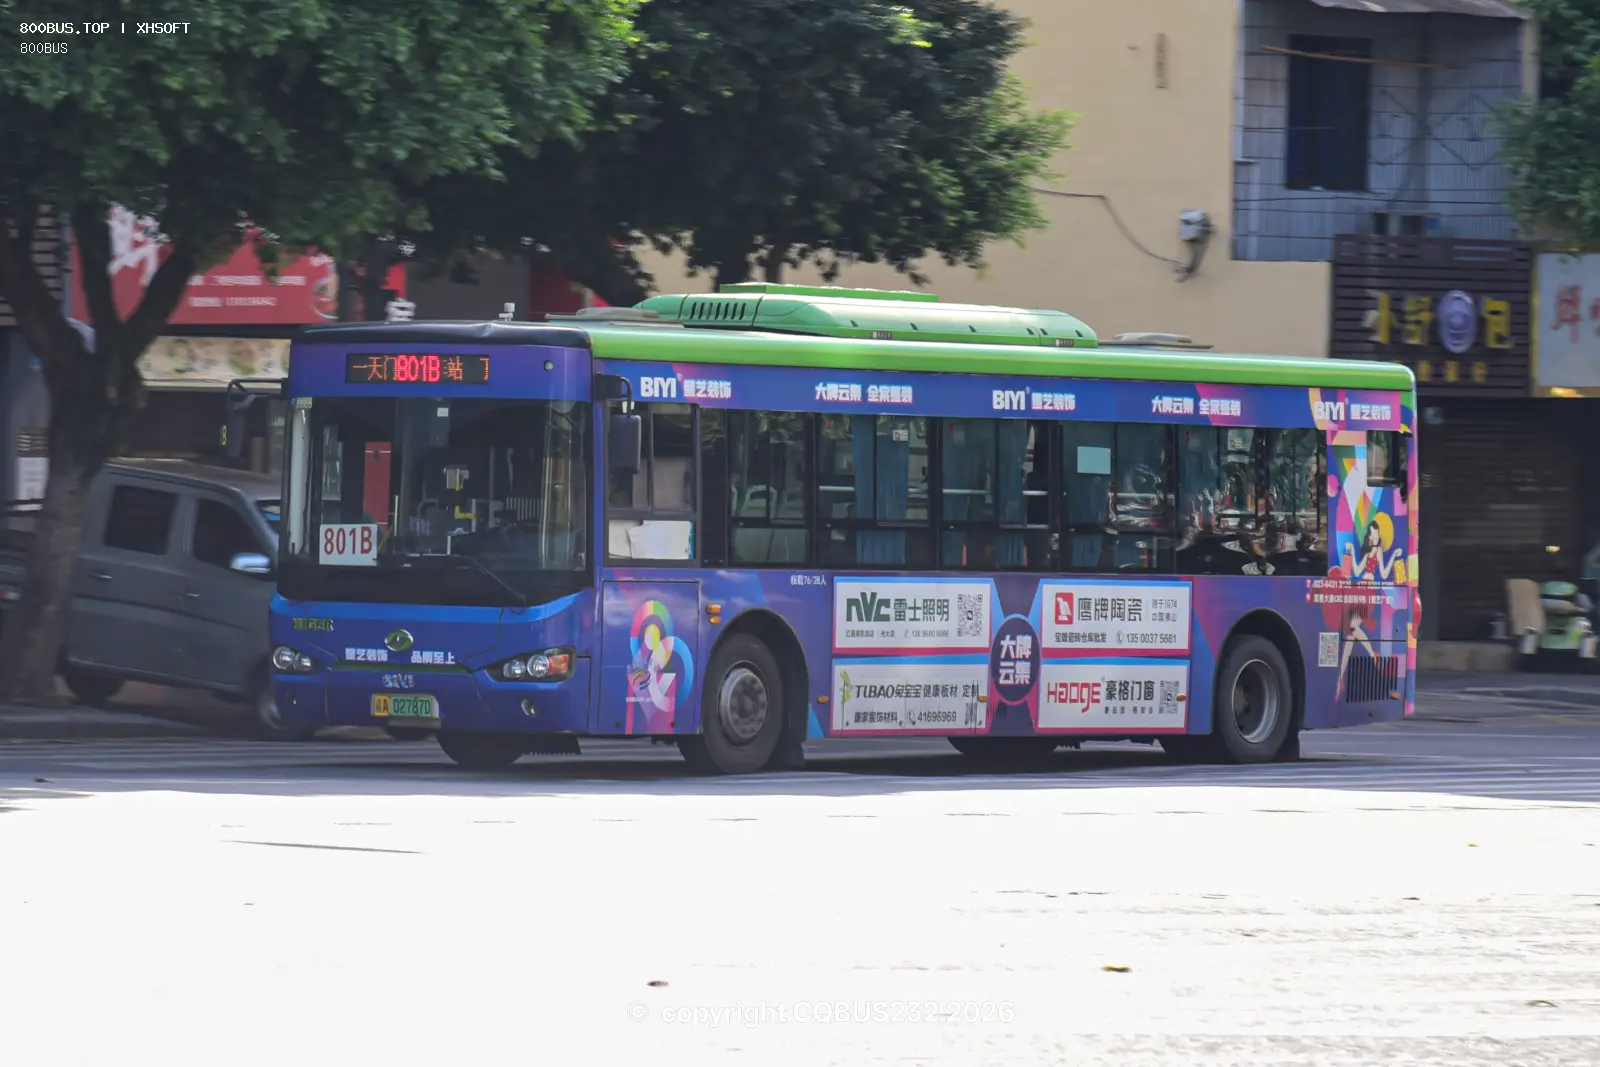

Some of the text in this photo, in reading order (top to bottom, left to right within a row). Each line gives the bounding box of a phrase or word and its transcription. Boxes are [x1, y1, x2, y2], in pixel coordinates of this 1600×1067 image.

[396, 354, 440, 382] 801B
[640, 376, 677, 398] BIYI
[815, 382, 862, 401] 大牌云集
[992, 389, 1026, 411] BIYI
[1152, 395, 1194, 414] 大牌云集
[1313, 401, 1345, 421] BIYI
[324, 526, 373, 555] 801B
[893, 598, 949, 622] 雷士照明
[1077, 597, 1143, 622] 鹰牌陶瓷
[1000, 634, 1032, 659] 大牌
[1126, 633, 1177, 643] 135 0037 5661
[999, 660, 1031, 685] 云集
[1105, 679, 1155, 701] 豪格门窗
[917, 711, 957, 722] 41696969
